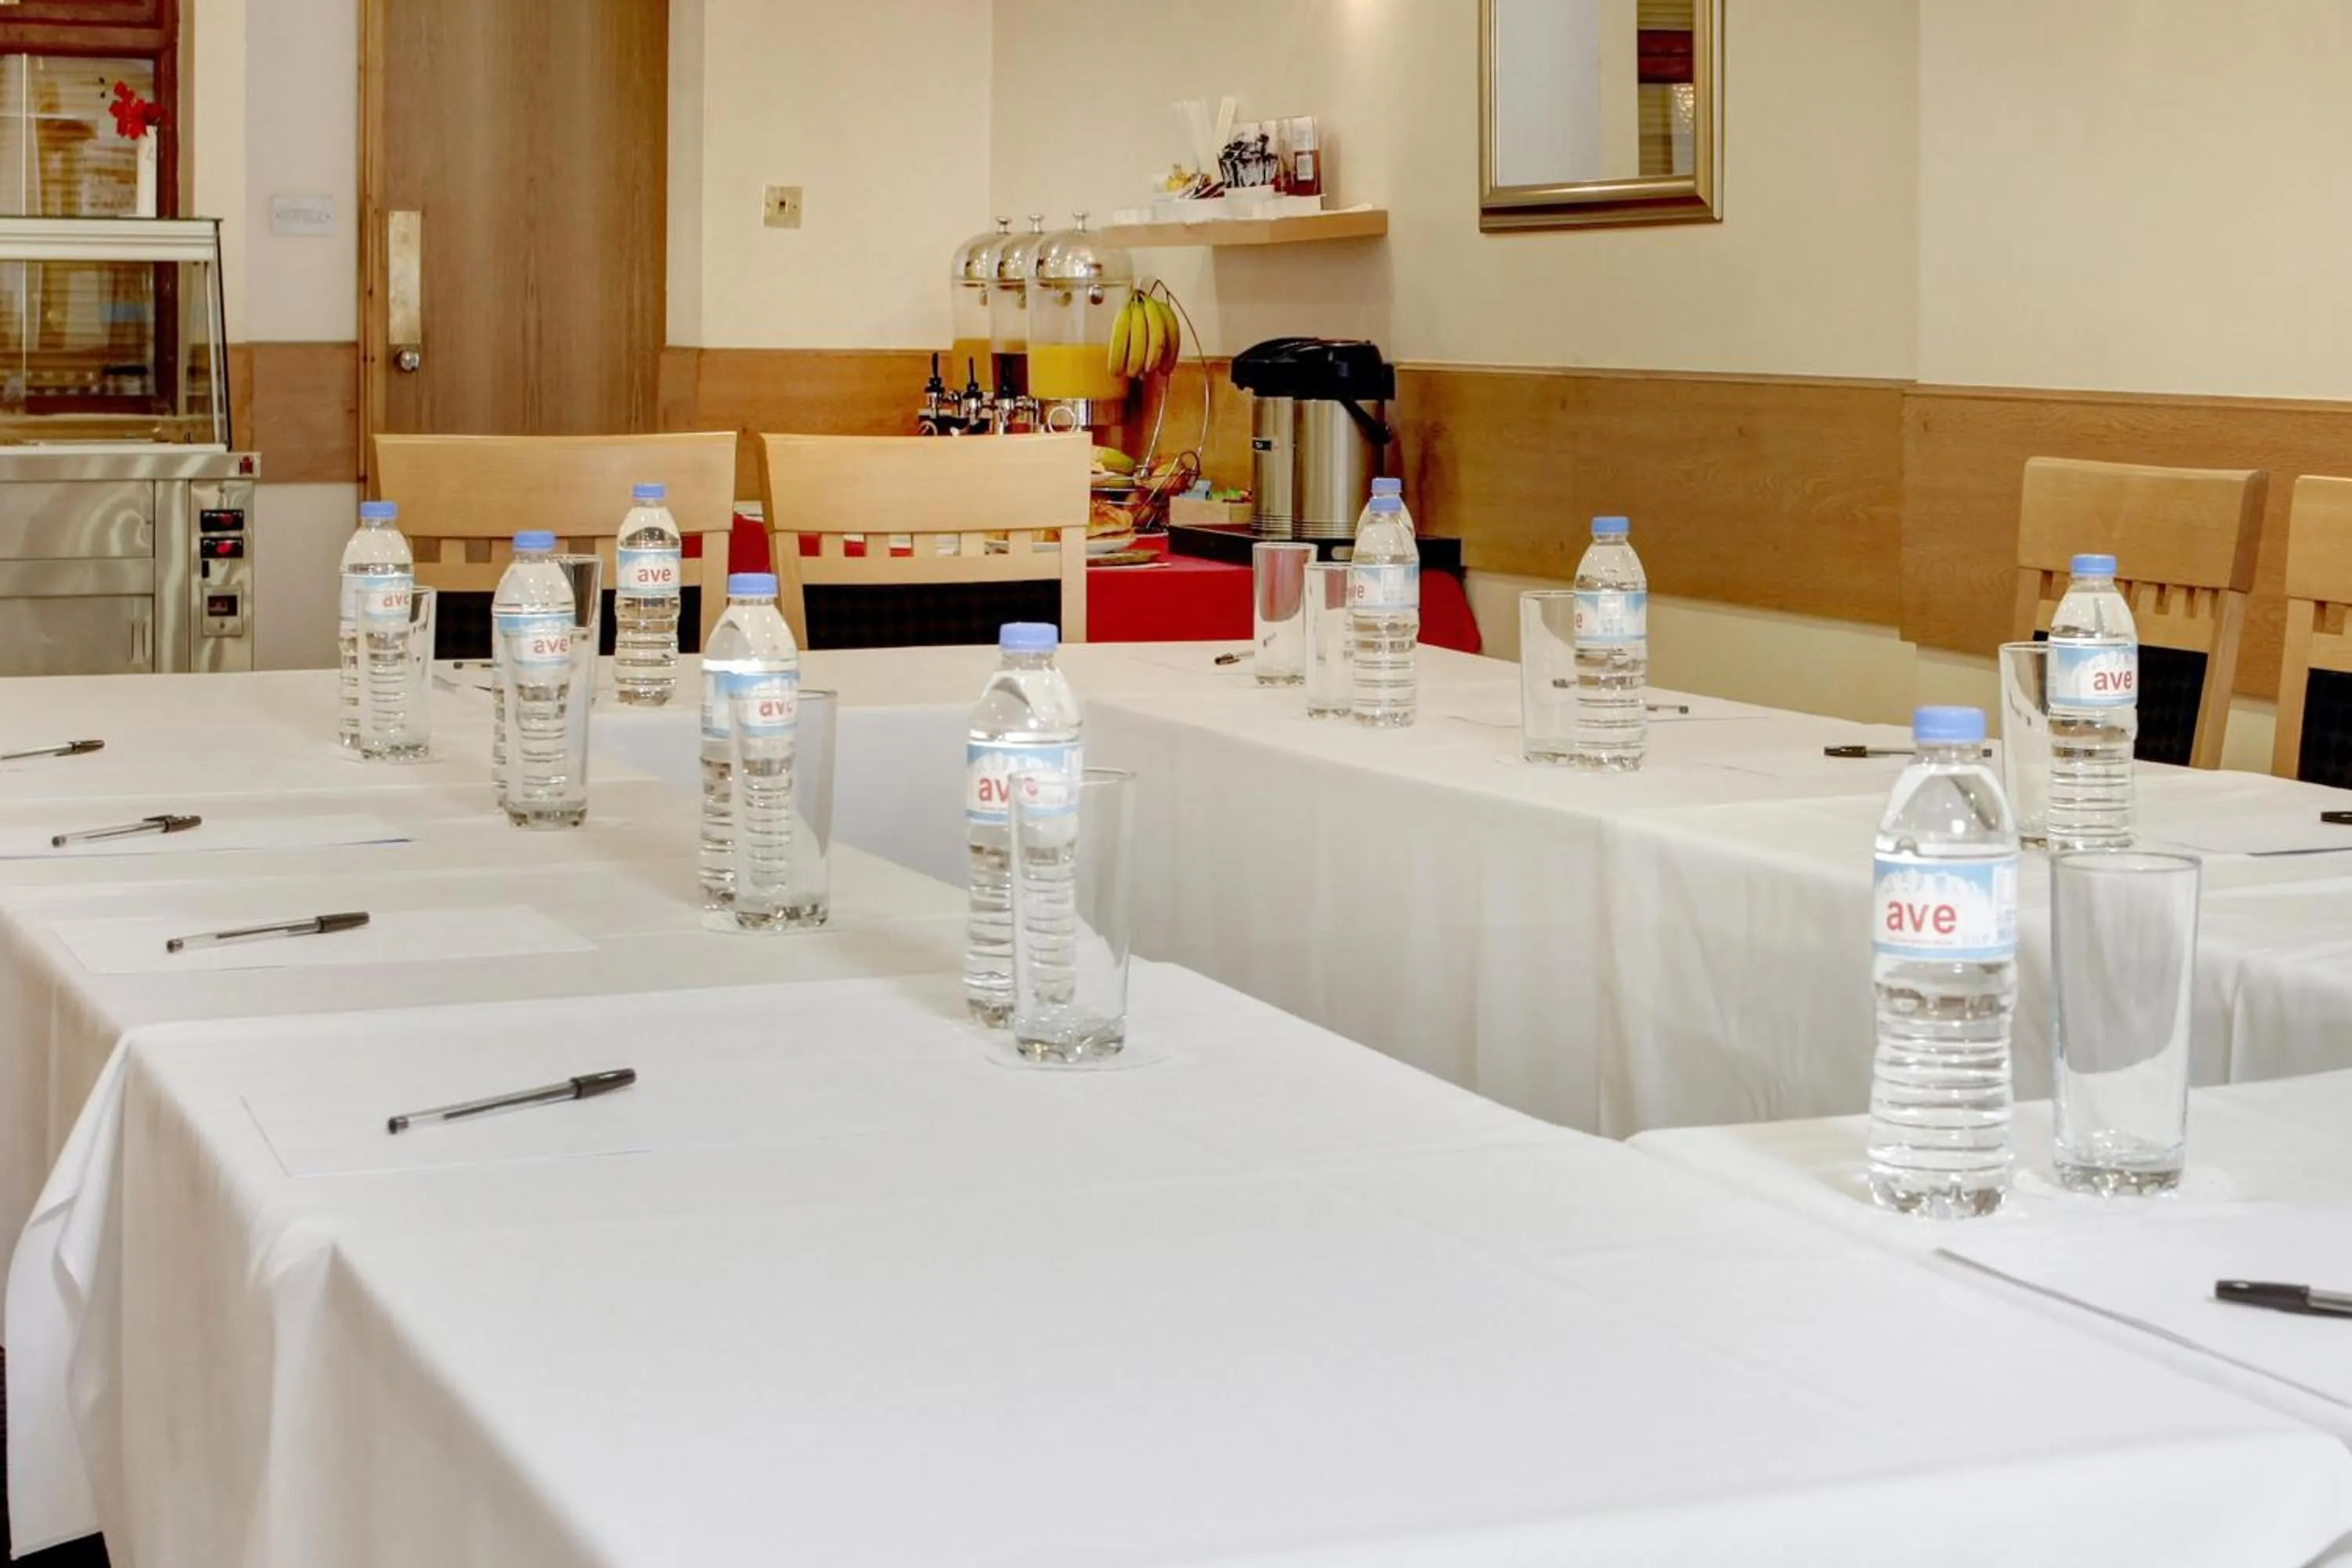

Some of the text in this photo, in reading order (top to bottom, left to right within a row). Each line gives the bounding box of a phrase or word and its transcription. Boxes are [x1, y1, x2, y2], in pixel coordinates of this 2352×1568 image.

[638, 568, 672, 583] ave
[534, 639, 568, 653] ave
[2093, 671, 2132, 691] ave
[1886, 901, 1956, 935] ave
